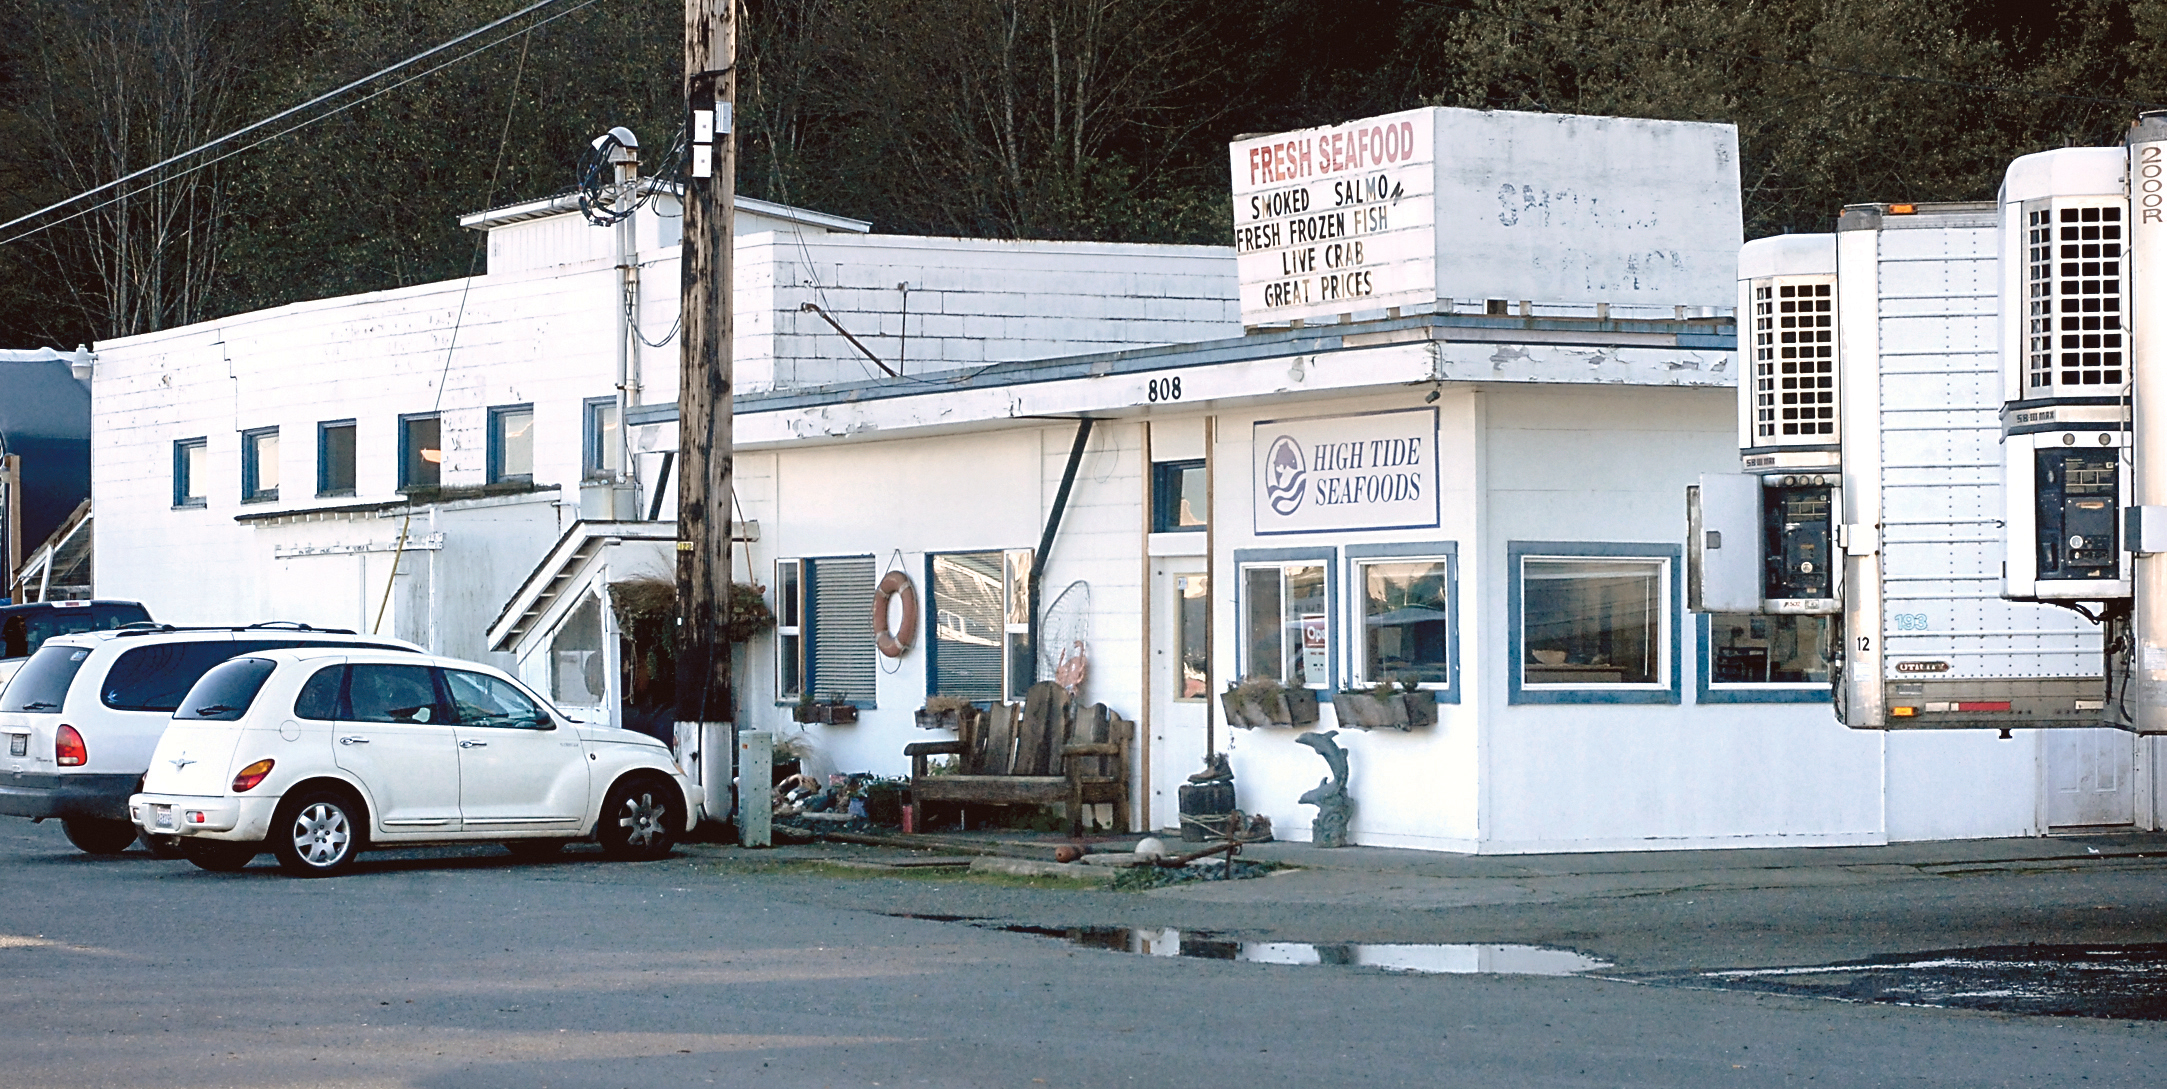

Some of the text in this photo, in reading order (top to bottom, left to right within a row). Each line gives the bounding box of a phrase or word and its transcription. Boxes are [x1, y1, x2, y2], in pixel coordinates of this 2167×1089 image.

[1249, 121, 1414, 186] FRESH SEAFOOD
[1251, 174, 1404, 220] SMOKED SALMON
[1237, 205, 1388, 252] FRESH FROZEN FISH
[1282, 241, 1364, 275] LIVE CRAB
[1264, 270, 1373, 308] GREAT PRICES
[1148, 376, 1182, 403] 808
[1312, 437, 1422, 472] HIGH TIDE
[1315, 472, 1421, 506] SEAFOODS
[1894, 613, 1928, 631] 193
[1857, 636, 1870, 652] 12
